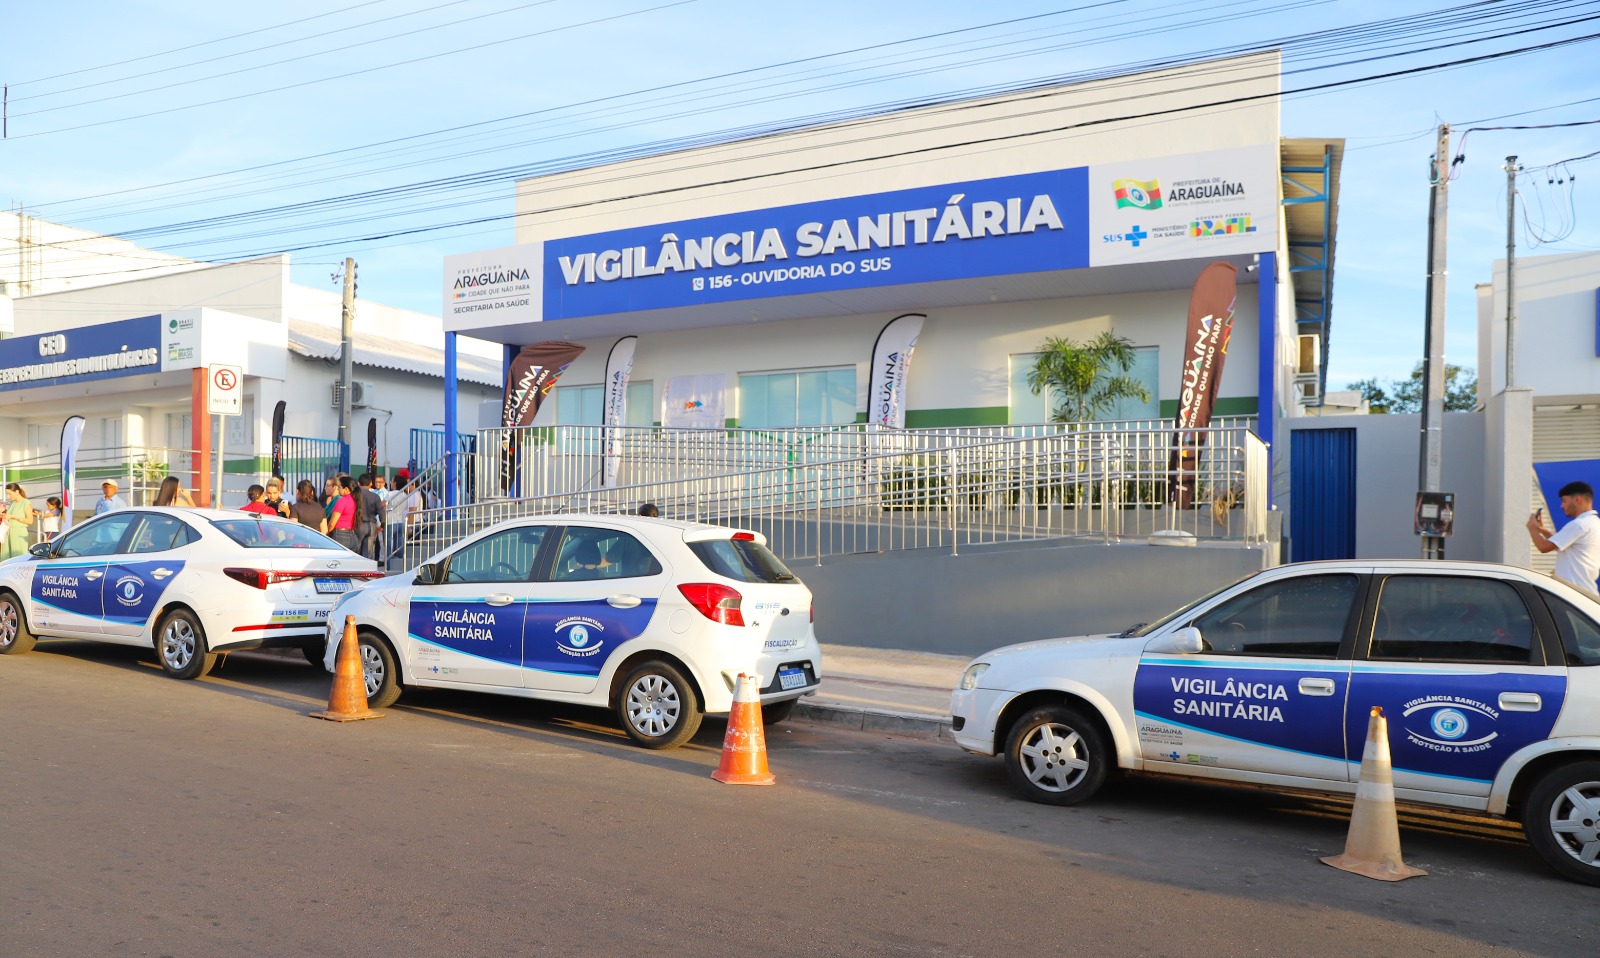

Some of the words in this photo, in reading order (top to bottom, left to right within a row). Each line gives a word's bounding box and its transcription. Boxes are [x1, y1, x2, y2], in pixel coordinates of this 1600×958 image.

[1168, 181, 1245, 202] ARAGUAÍNA
[1173, 179, 1210, 187] PREFEITURA
[1152, 224, 1187, 232] MINISTÉRIO
[1165, 230, 1186, 238] SAÚDE
[1190, 216, 1257, 238] BRASIL
[558, 232, 788, 285] VIGILÂNCIA
[796, 193, 1064, 257] SANITÁRIA
[1103, 233, 1123, 243] SUS
[458, 264, 502, 275] PREFEITURA
[831, 261, 856, 277] DO
[860, 257, 891, 273] SUS
[454, 268, 530, 290] ARAGUAÍNA
[468, 289, 487, 297] CIDADE
[489, 288, 500, 296] QUE
[453, 303, 494, 314] SECRETARIA
[506, 299, 529, 308] SAÚDE
[39, 334, 66, 357] CEO
[1188, 393, 1204, 429] CIDADE
[1199, 370, 1209, 392] QUE
[1210, 317, 1223, 345] PARA
[520, 401, 531, 413] QUE
[527, 385, 539, 401] NÃO
[535, 369, 551, 386] PARA
[42, 574, 79, 587] VIGILÂNCIA
[41, 587, 78, 599] SANITÁRIA
[434, 609, 496, 625] VIGILÂNCIA
[434, 625, 493, 641] SANITÁRIA
[764, 638, 798, 648] FISCALIZAÇÃO
[1170, 677, 1289, 701] VIGILÂNCIA
[1173, 698, 1285, 723] SANITÁRIA
[1403, 695, 1453, 710] VIGILÂNCIA
[1454, 696, 1500, 719] SANITÁRIA
[1407, 734, 1452, 753] PROTEÇÃO
[1462, 742, 1492, 753] SAÚDE
